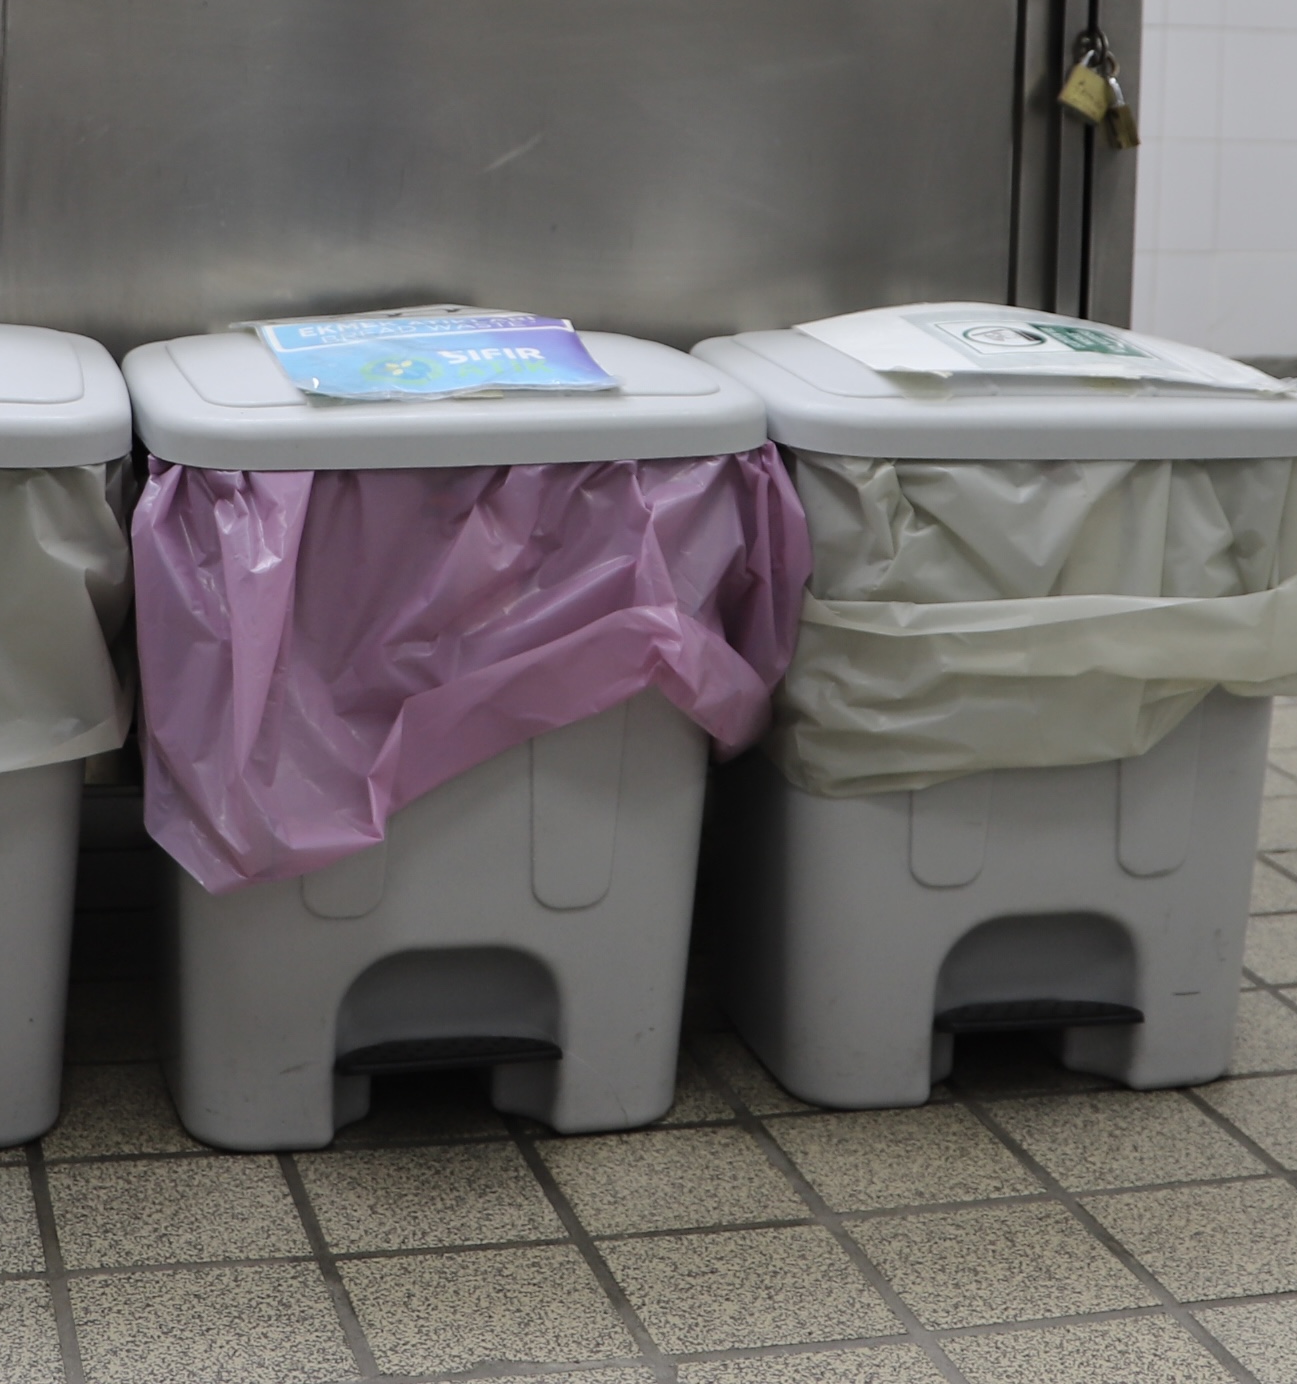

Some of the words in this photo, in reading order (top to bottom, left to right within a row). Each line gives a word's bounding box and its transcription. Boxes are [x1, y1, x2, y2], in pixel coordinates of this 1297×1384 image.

[298, 320, 398, 337] EKMEK
[438, 347, 546, 364] SIFIR
[459, 359, 553, 378] ATIK
